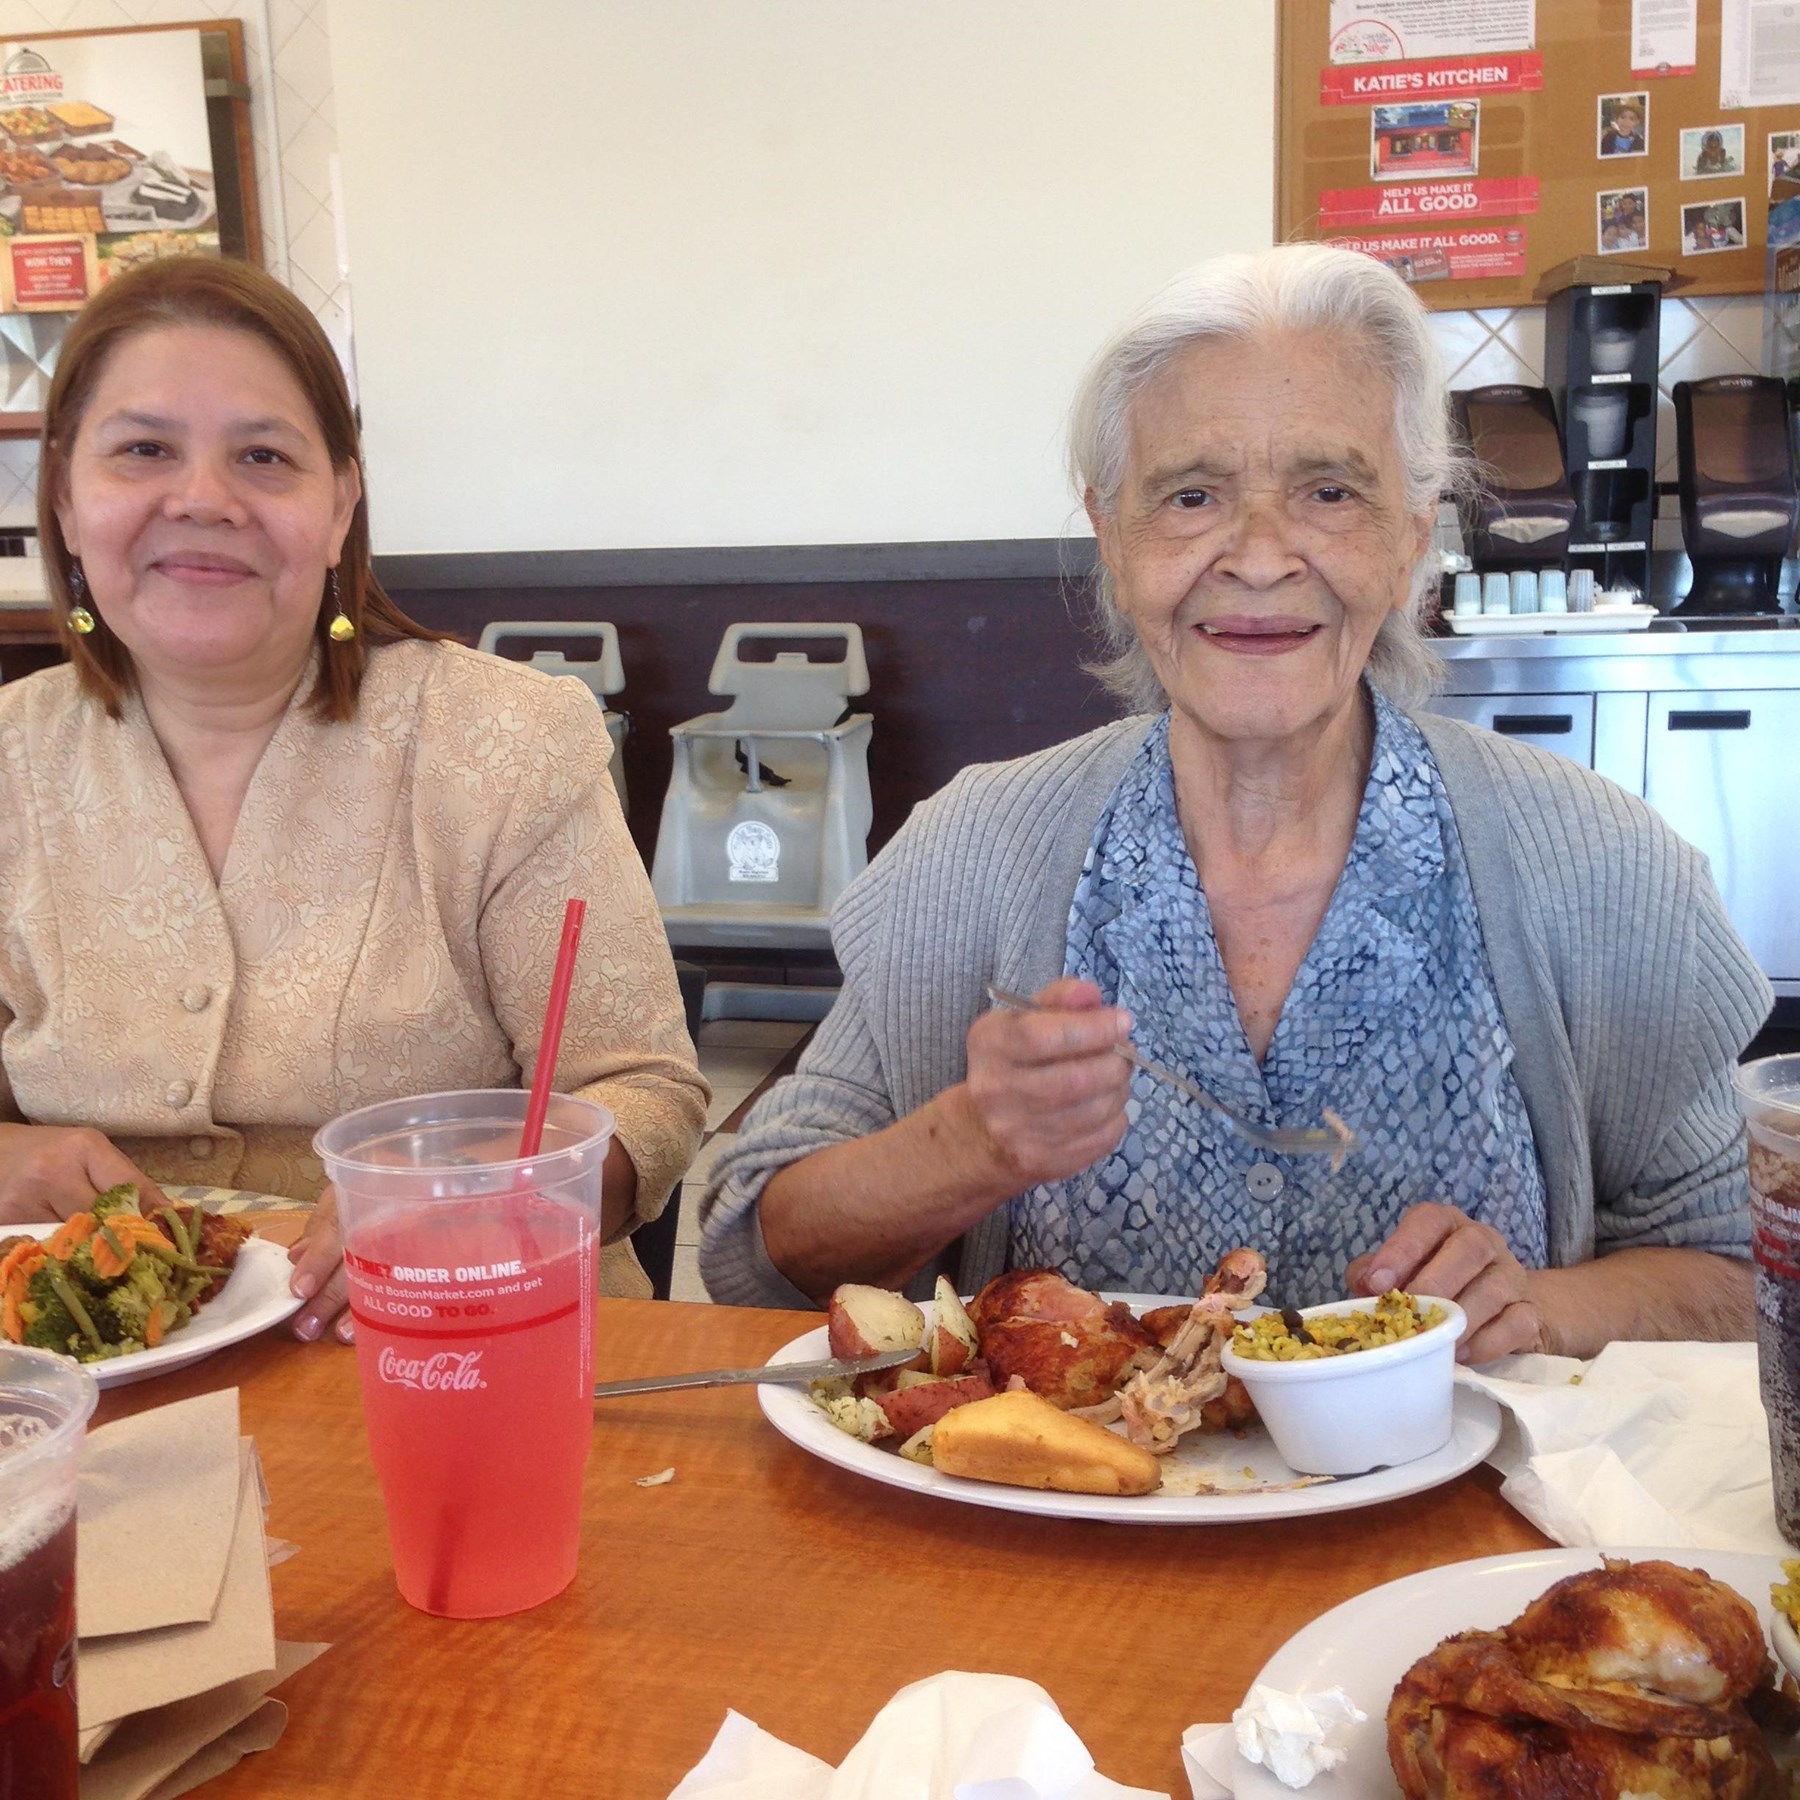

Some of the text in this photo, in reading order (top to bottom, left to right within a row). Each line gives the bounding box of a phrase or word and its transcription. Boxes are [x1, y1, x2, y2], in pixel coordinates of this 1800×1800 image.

[1354, 66, 1508, 92] KATIE'S KITCHEN
[1383, 183, 1473, 198] HELP US MAKE IT
[1378, 193, 1478, 215] ALL GOOD
[1363, 239, 1380, 251] US
[1381, 238, 1418, 250] MAKE
[1419, 237, 1432, 248] IT
[1433, 235, 1457, 248] ALL
[1459, 233, 1501, 246] GOOD.
[393, 1265, 450, 1283] ORDER
[454, 1259, 527, 1283] ONLINE.
[375, 1284, 385, 1295] at
[386, 1286, 494, 1301] BostonMarket.com
[497, 1283, 521, 1295] and
[523, 1277, 543, 1292] get
[363, 1295, 496, 1319] ALL GOOD TO GO.
[378, 1346, 487, 1391] Coca-Cola
